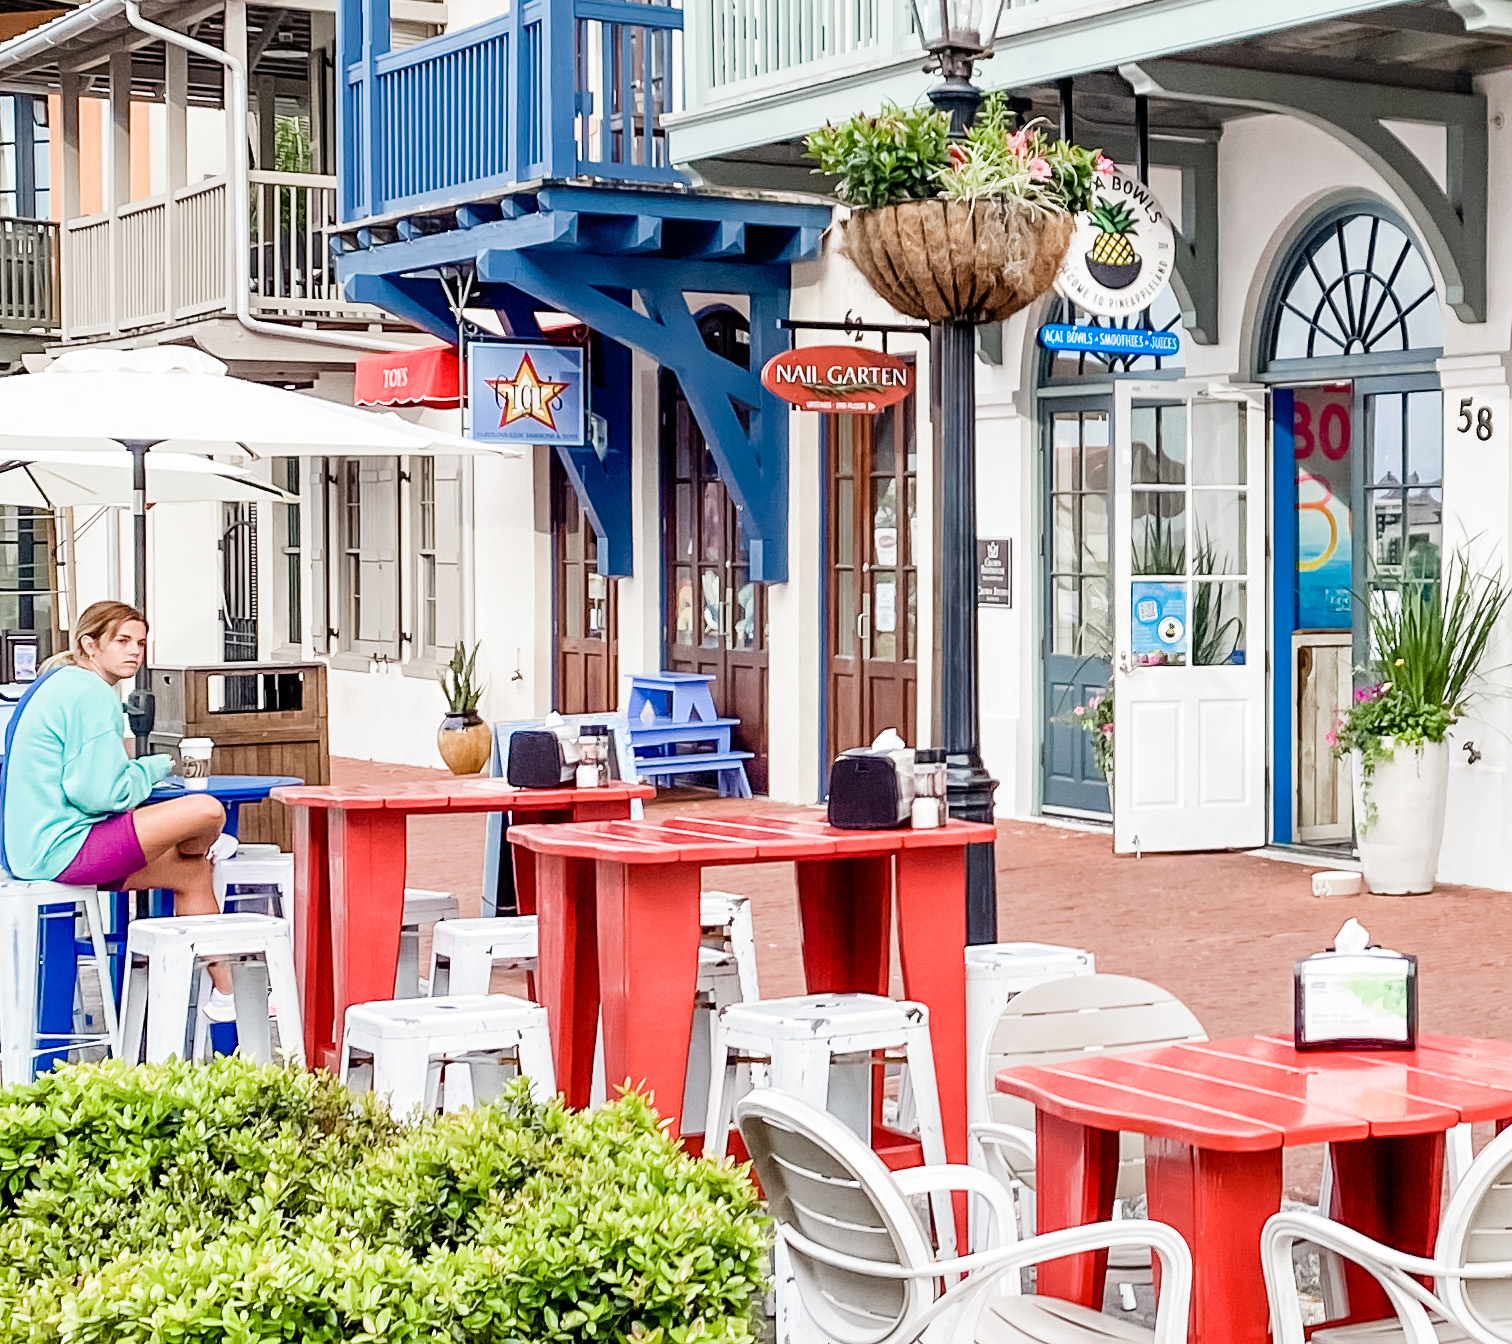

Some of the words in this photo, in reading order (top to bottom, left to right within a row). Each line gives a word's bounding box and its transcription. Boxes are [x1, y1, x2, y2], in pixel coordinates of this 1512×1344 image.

[1112, 176, 1162, 223] BOWLS
[1066, 330, 1093, 344] BOWLS
[1100, 333, 1143, 348] SMOOTHIES
[1150, 336, 1177, 350] JUICES
[383, 367, 408, 388] TOYS
[776, 364, 821, 384] NAIL
[826, 366, 907, 386] GARTEN
[1457, 396, 1494, 441] 58
